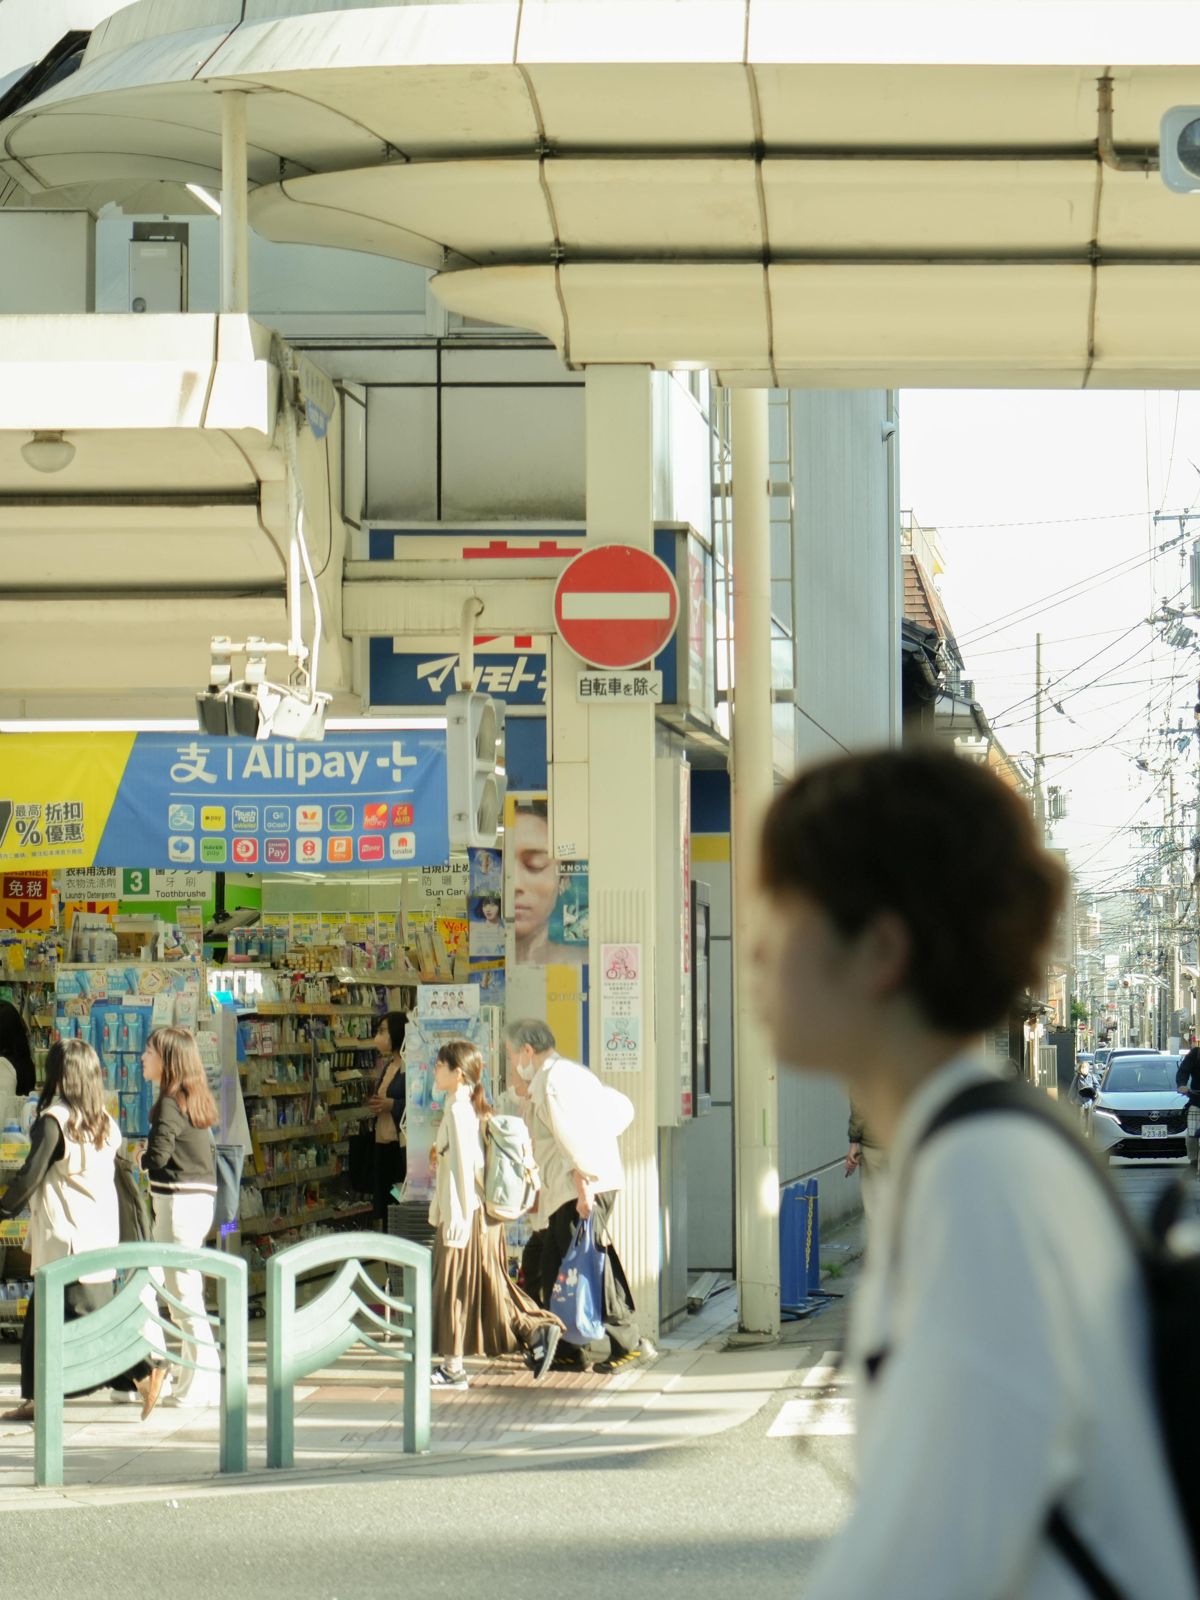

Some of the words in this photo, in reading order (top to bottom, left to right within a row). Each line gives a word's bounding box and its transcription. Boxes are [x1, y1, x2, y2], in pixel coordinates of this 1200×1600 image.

[417, 655, 546, 702] マツモト
[580, 677, 658, 696] 自転車を除く
[16, 804, 40, 817] 最高
[46, 802, 81, 821] 折扣
[46, 823, 82, 842] 優惠
[268, 848, 286, 860] Pay
[8, 879, 42, 898] 免税
[130, 871, 143, 892] 3
[446, 888, 466, 896] Car
